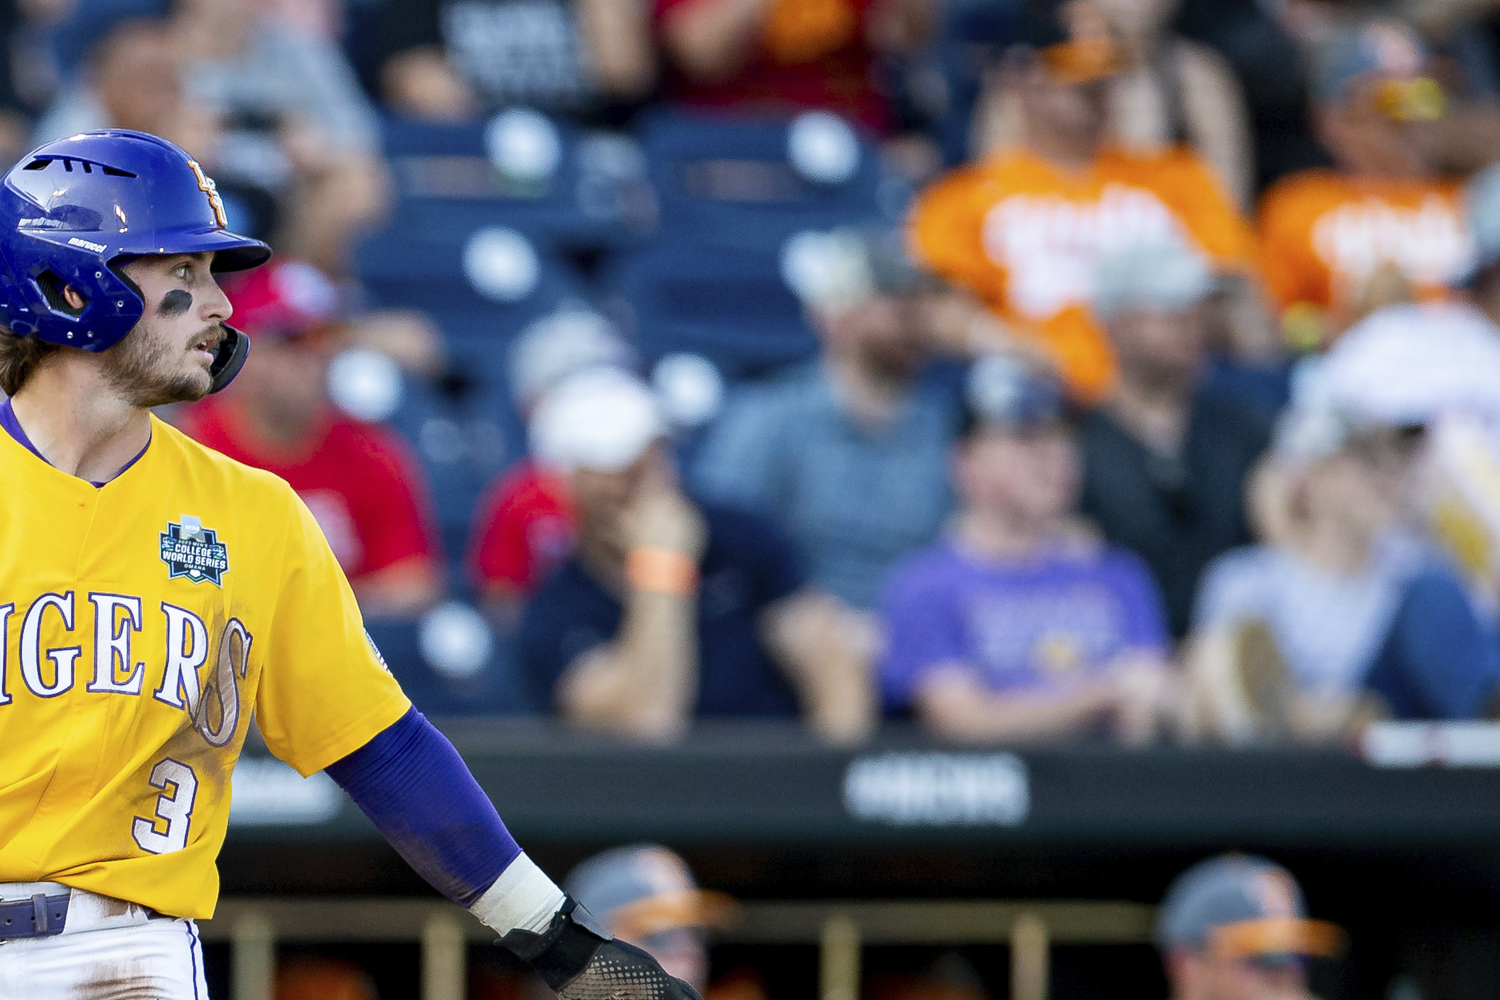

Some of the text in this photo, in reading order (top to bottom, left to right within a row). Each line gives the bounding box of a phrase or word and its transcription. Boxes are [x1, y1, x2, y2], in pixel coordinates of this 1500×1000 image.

[67, 237, 107, 253] marucci
[175, 543, 212, 558] COLLEGE
[162, 551, 226, 569] WORLD SERIES
[184, 563, 206, 571] OMAHA
[131, 756, 199, 855] 3
